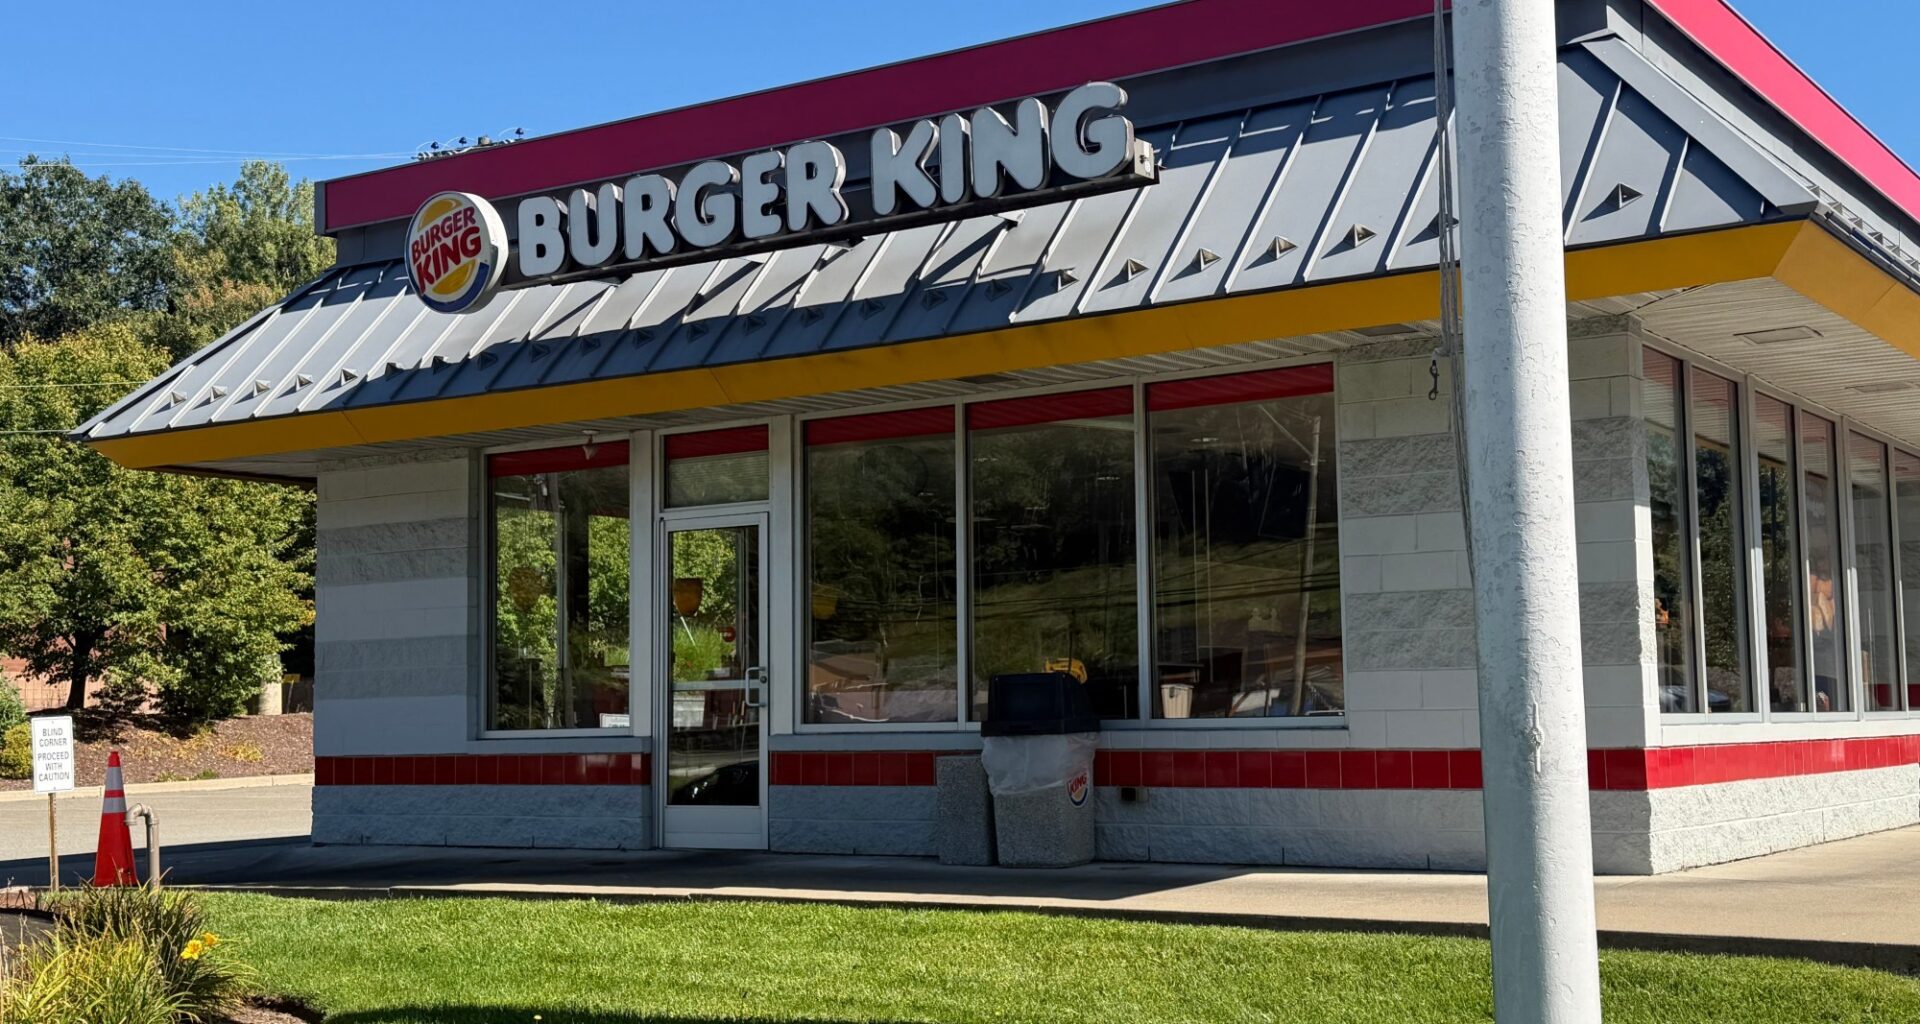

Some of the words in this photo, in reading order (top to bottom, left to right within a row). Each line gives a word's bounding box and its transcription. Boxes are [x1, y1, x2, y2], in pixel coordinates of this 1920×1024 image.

[516, 140, 849, 278] BURGER
[870, 82, 1132, 216] KING
[411, 206, 477, 265] BURGER
[416, 226, 482, 294] KING
[42, 728, 63, 736] BLIND
[39, 738, 67, 747] CORNER
[37, 752, 70, 761] PROCEED
[45, 763, 63, 771] WITH
[38, 772, 70, 781] CAUTION
